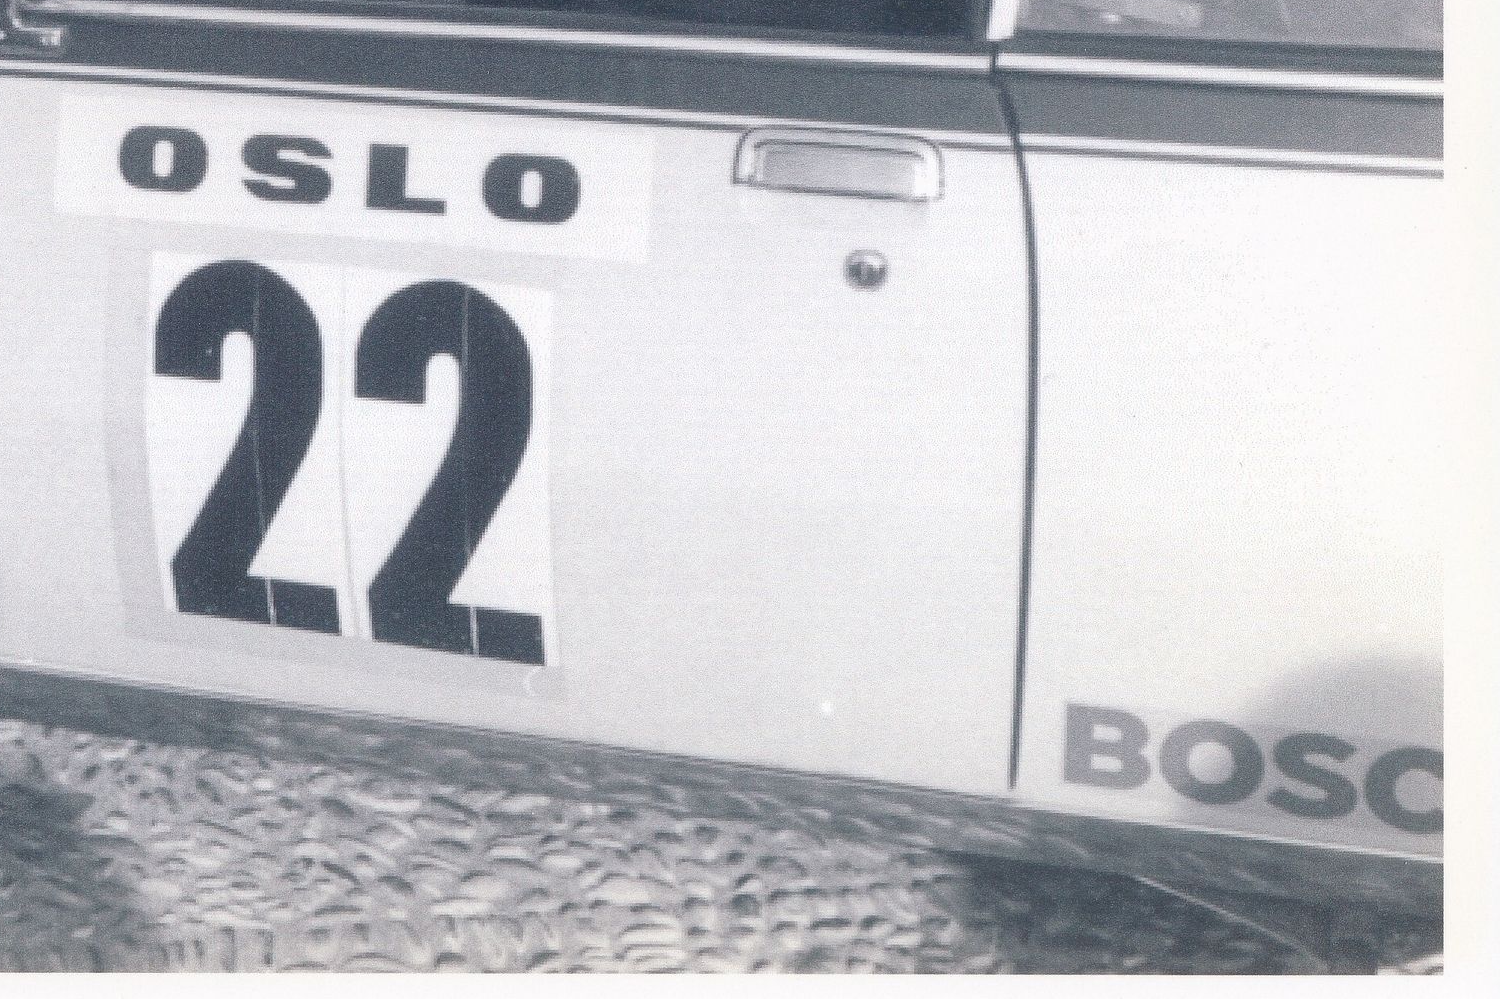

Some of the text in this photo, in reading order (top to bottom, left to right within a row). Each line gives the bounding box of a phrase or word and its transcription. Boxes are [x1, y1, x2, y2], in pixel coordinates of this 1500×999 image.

[119, 125, 581, 225] OSLO
[154, 259, 546, 666] 22
[1063, 702, 1444, 835] BOSC
